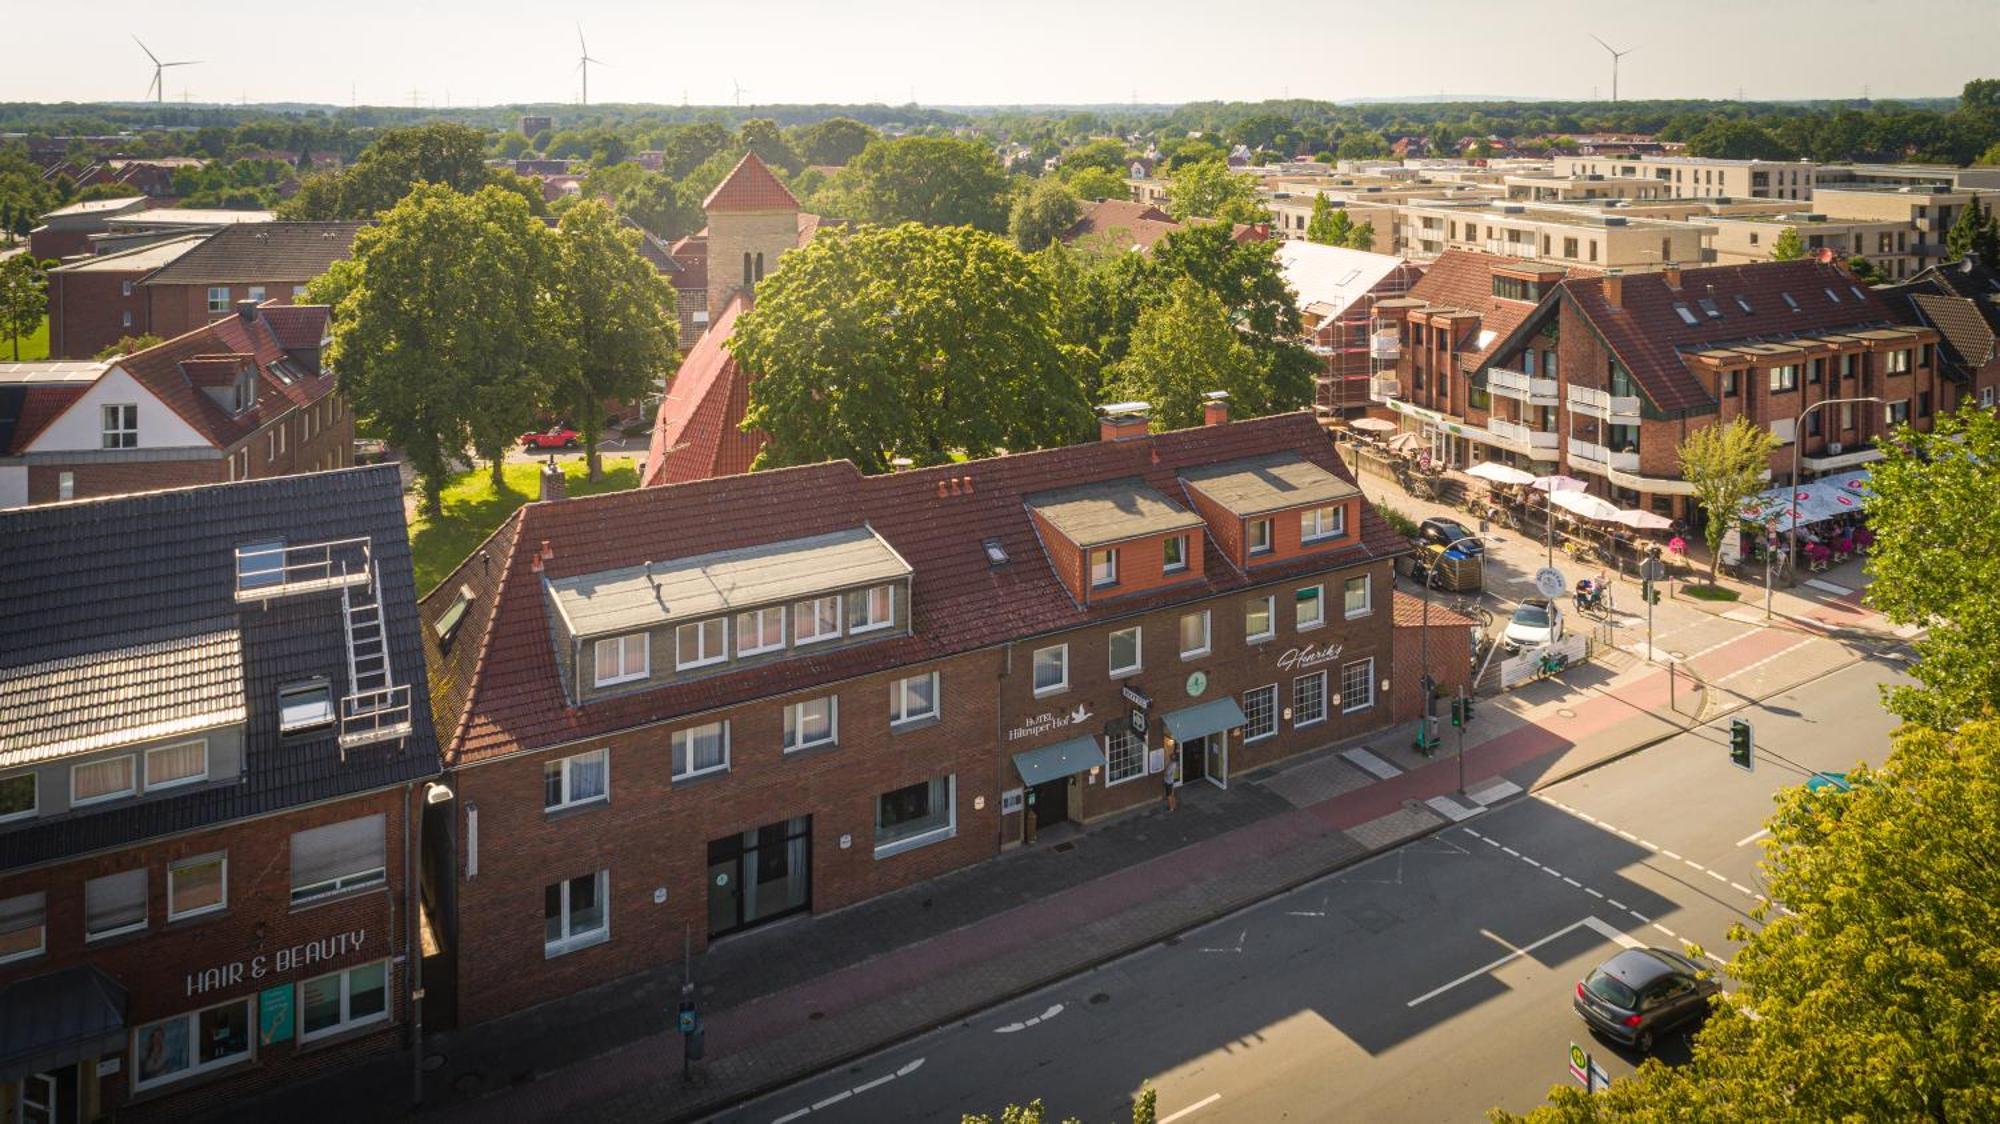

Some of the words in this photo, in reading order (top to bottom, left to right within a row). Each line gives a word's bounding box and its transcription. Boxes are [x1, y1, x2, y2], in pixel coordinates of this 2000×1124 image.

[1008, 723, 1051, 741] Hiltruper
[1052, 715, 1071, 729] Hof
[187, 962, 244, 996] HAIR
[251, 956, 266, 978] &
[276, 929, 365, 973] BEAUTY
